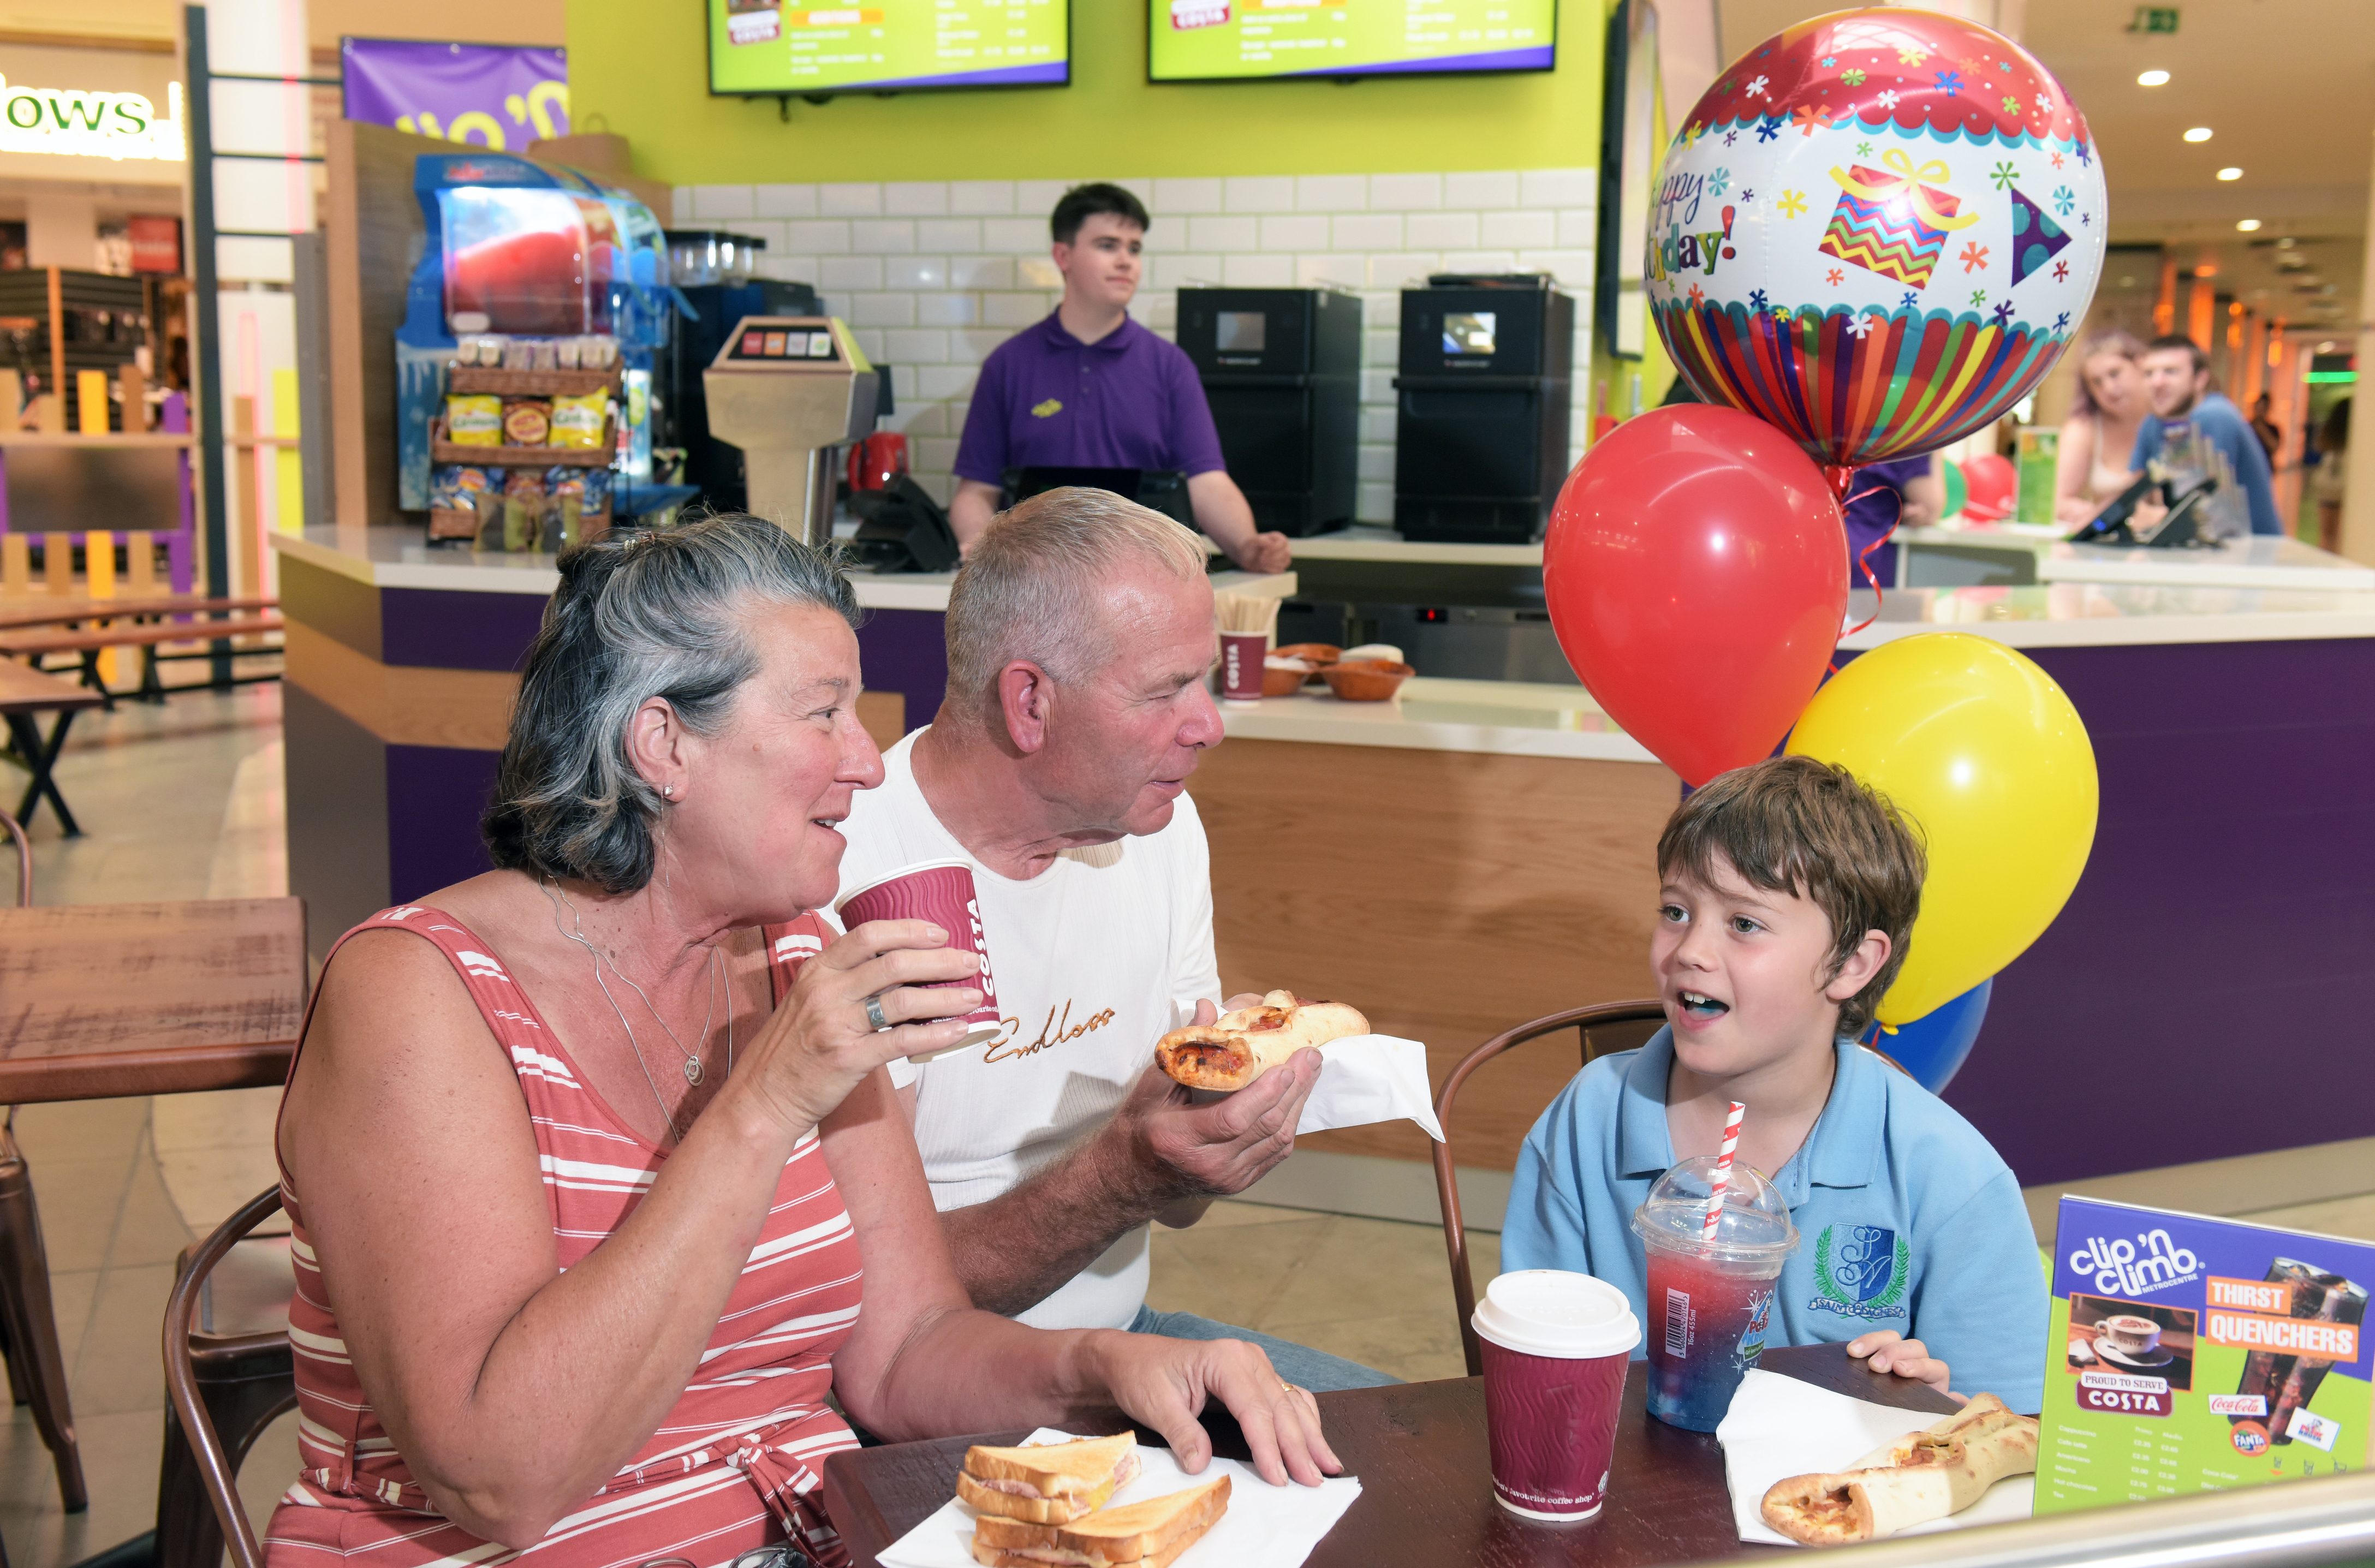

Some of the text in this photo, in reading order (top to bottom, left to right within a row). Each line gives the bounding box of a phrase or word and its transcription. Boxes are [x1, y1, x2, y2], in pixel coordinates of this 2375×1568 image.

[966, 899, 994, 997] COSTA
[2141, 1273, 2199, 1293] METROCENTRE
[2211, 1281, 2284, 1309] THIRST
[2119, 1338, 2142, 1347] COSTA
[2210, 1314, 2354, 1355] QUENCHERS
[2085, 1375, 2164, 1391] PROUD TO SERVE
[2088, 1390, 2160, 1411] COSTA
[2058, 1425, 2097, 1438] Cappuccino
[2056, 1452, 2091, 1464] Americano
[2055, 1464, 2077, 1474] Mocha
[2066, 1481, 2098, 1492] chocolate
[1510, 1488, 1545, 1503] favourite
[1547, 1496, 1573, 1505] coffee
[2053, 1491, 2064, 1499] Tea
